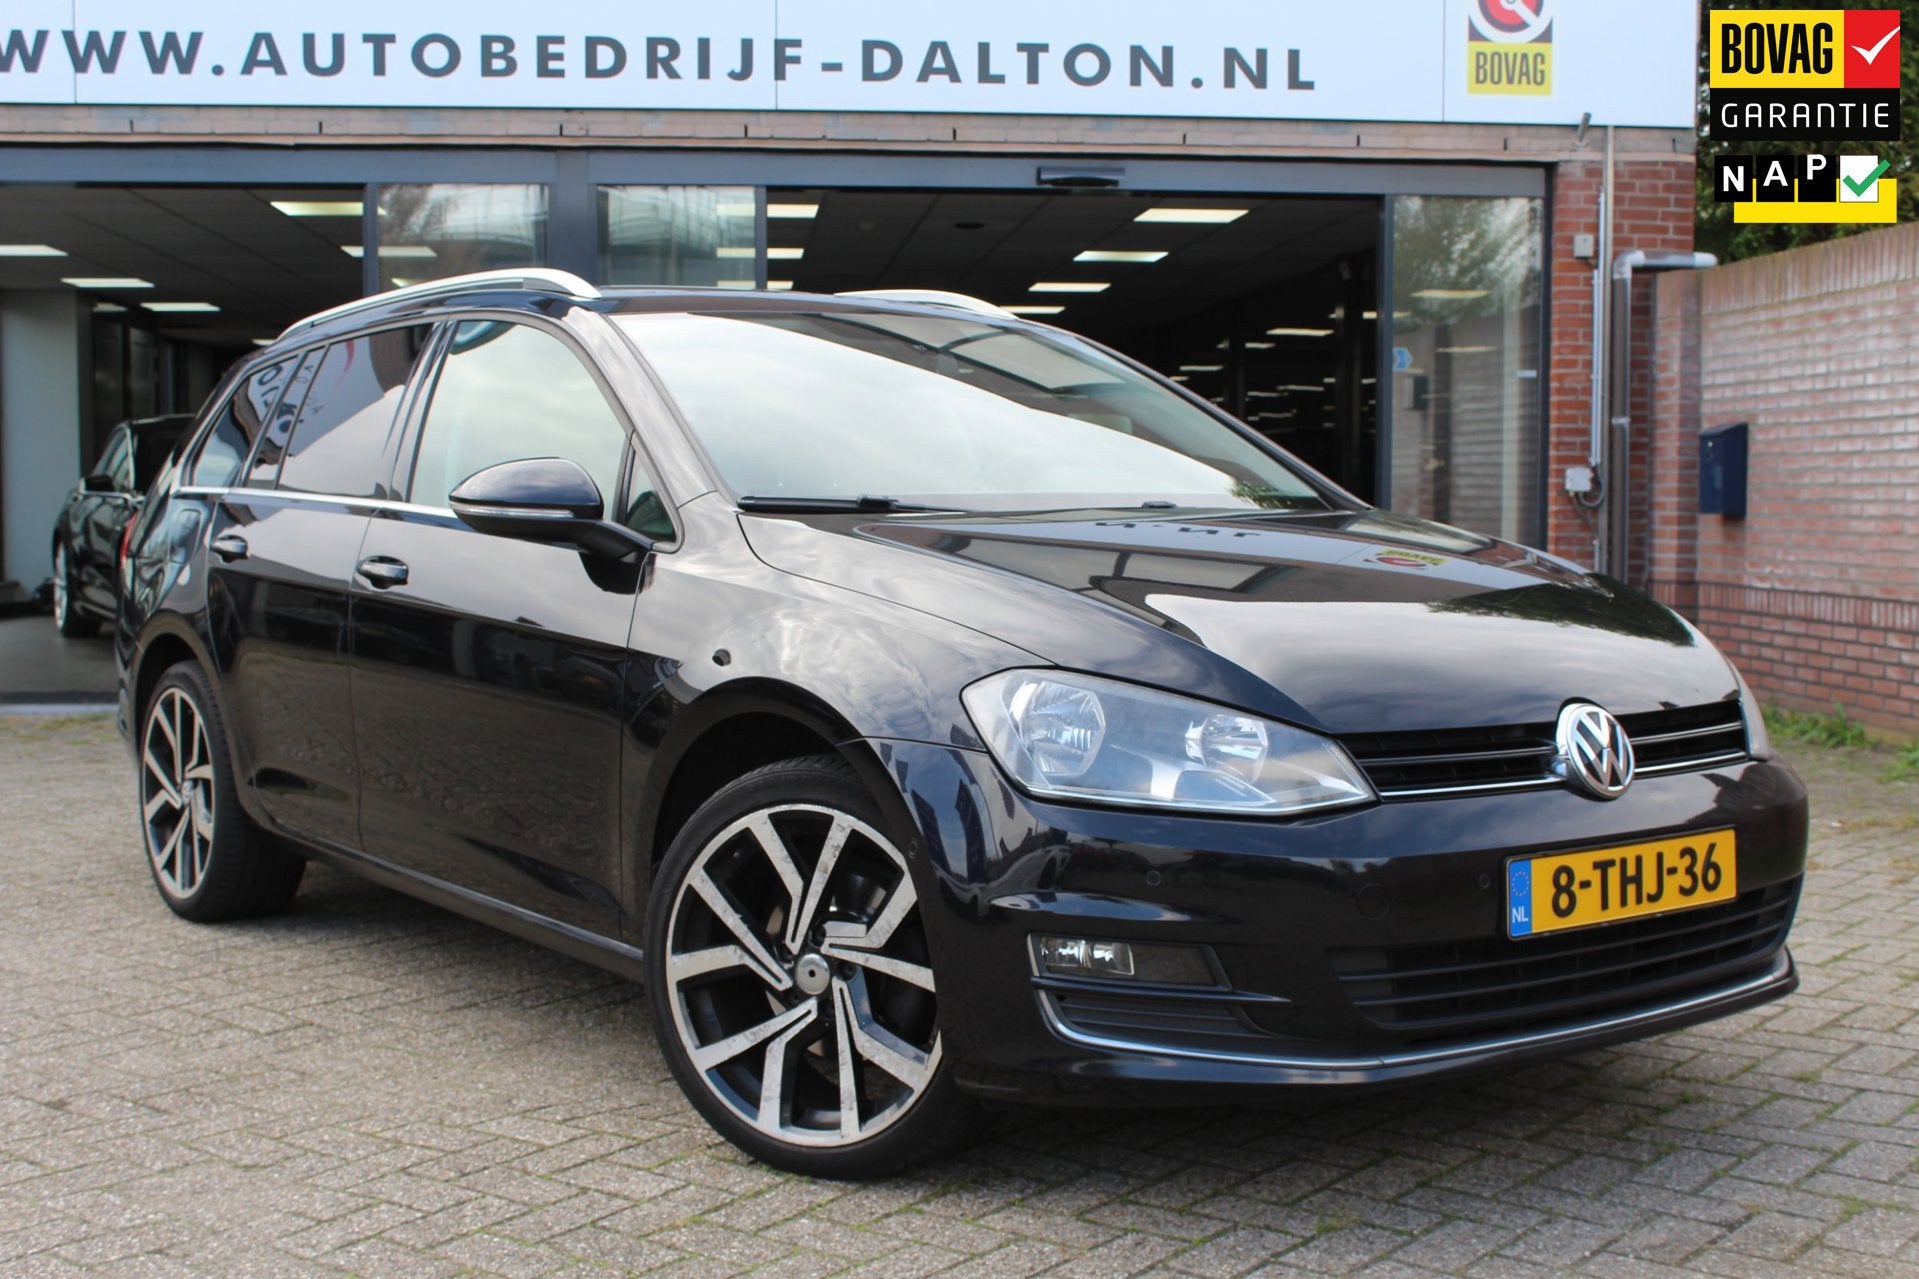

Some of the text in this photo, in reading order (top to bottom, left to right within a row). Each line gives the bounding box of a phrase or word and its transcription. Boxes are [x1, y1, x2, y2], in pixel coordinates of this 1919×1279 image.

[1475, 51, 1546, 86] BOVAG
[1551, 842, 1722, 918] 8-THJ-36
[1512, 906, 1529, 923] NL
